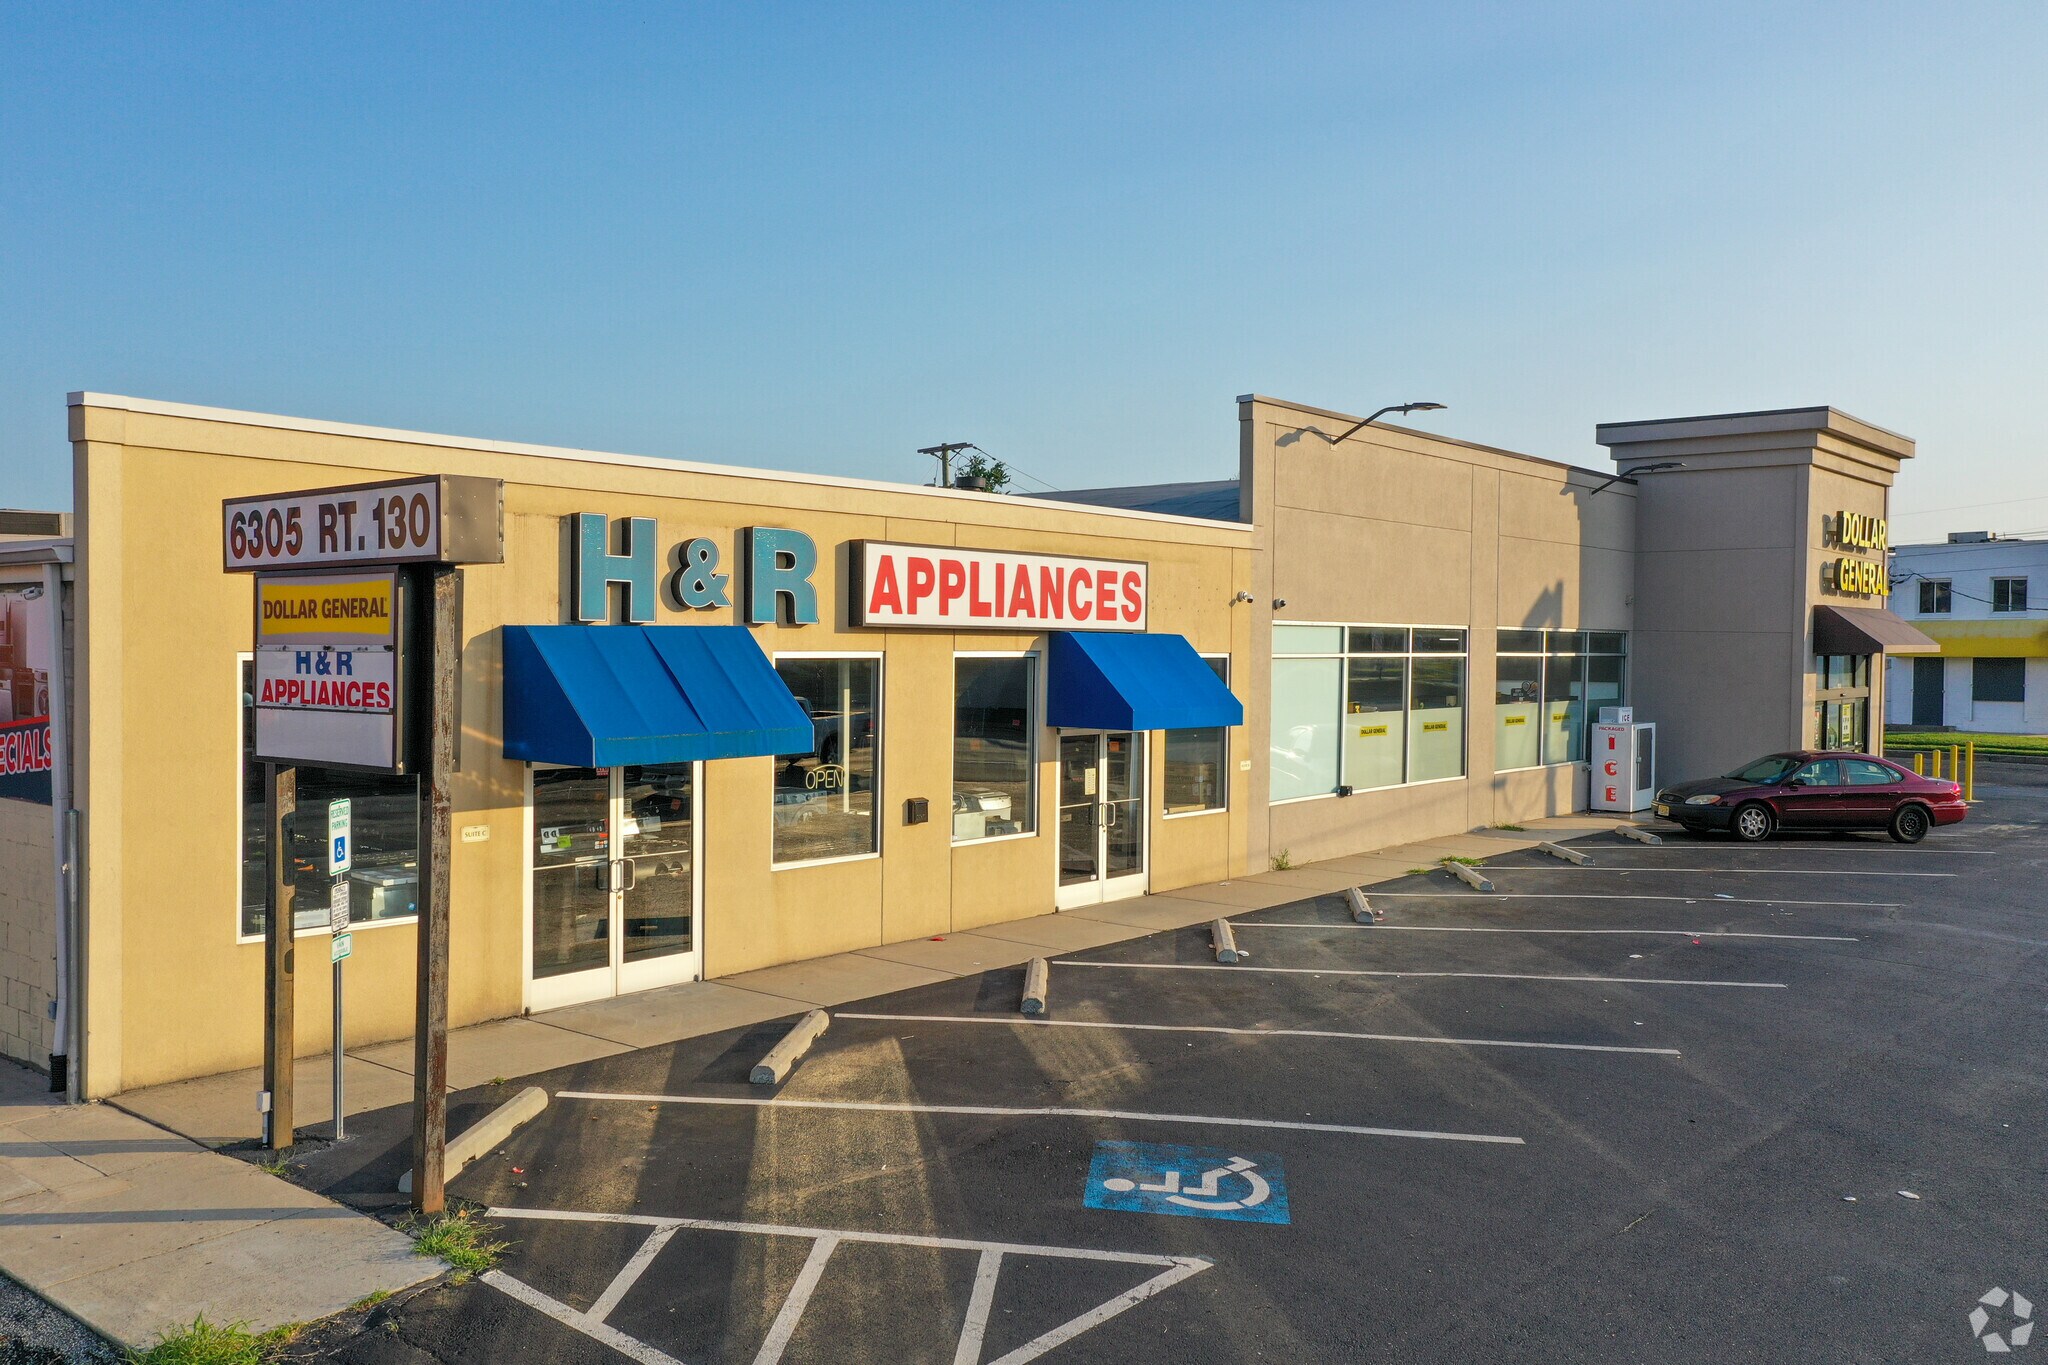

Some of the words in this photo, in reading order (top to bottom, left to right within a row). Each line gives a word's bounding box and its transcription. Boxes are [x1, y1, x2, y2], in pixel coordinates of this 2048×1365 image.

[230, 506, 303, 560] 6305
[1842, 510, 1887, 550] DOLLAR
[868, 554, 1143, 624] APPLIANCES
[1840, 558, 1889, 597] GENERAL
[263, 598, 318, 620] DOLLAR
[322, 597, 388, 619] GENERAL
[261, 678, 391, 708] APPLIANCES
[1621, 714, 1630, 722] ICE
[805, 769, 844, 790] OPEN
[330, 805, 349, 819] RESERVED
[331, 819, 348, 831] PARKING
[464, 830, 480, 838] SUITE
